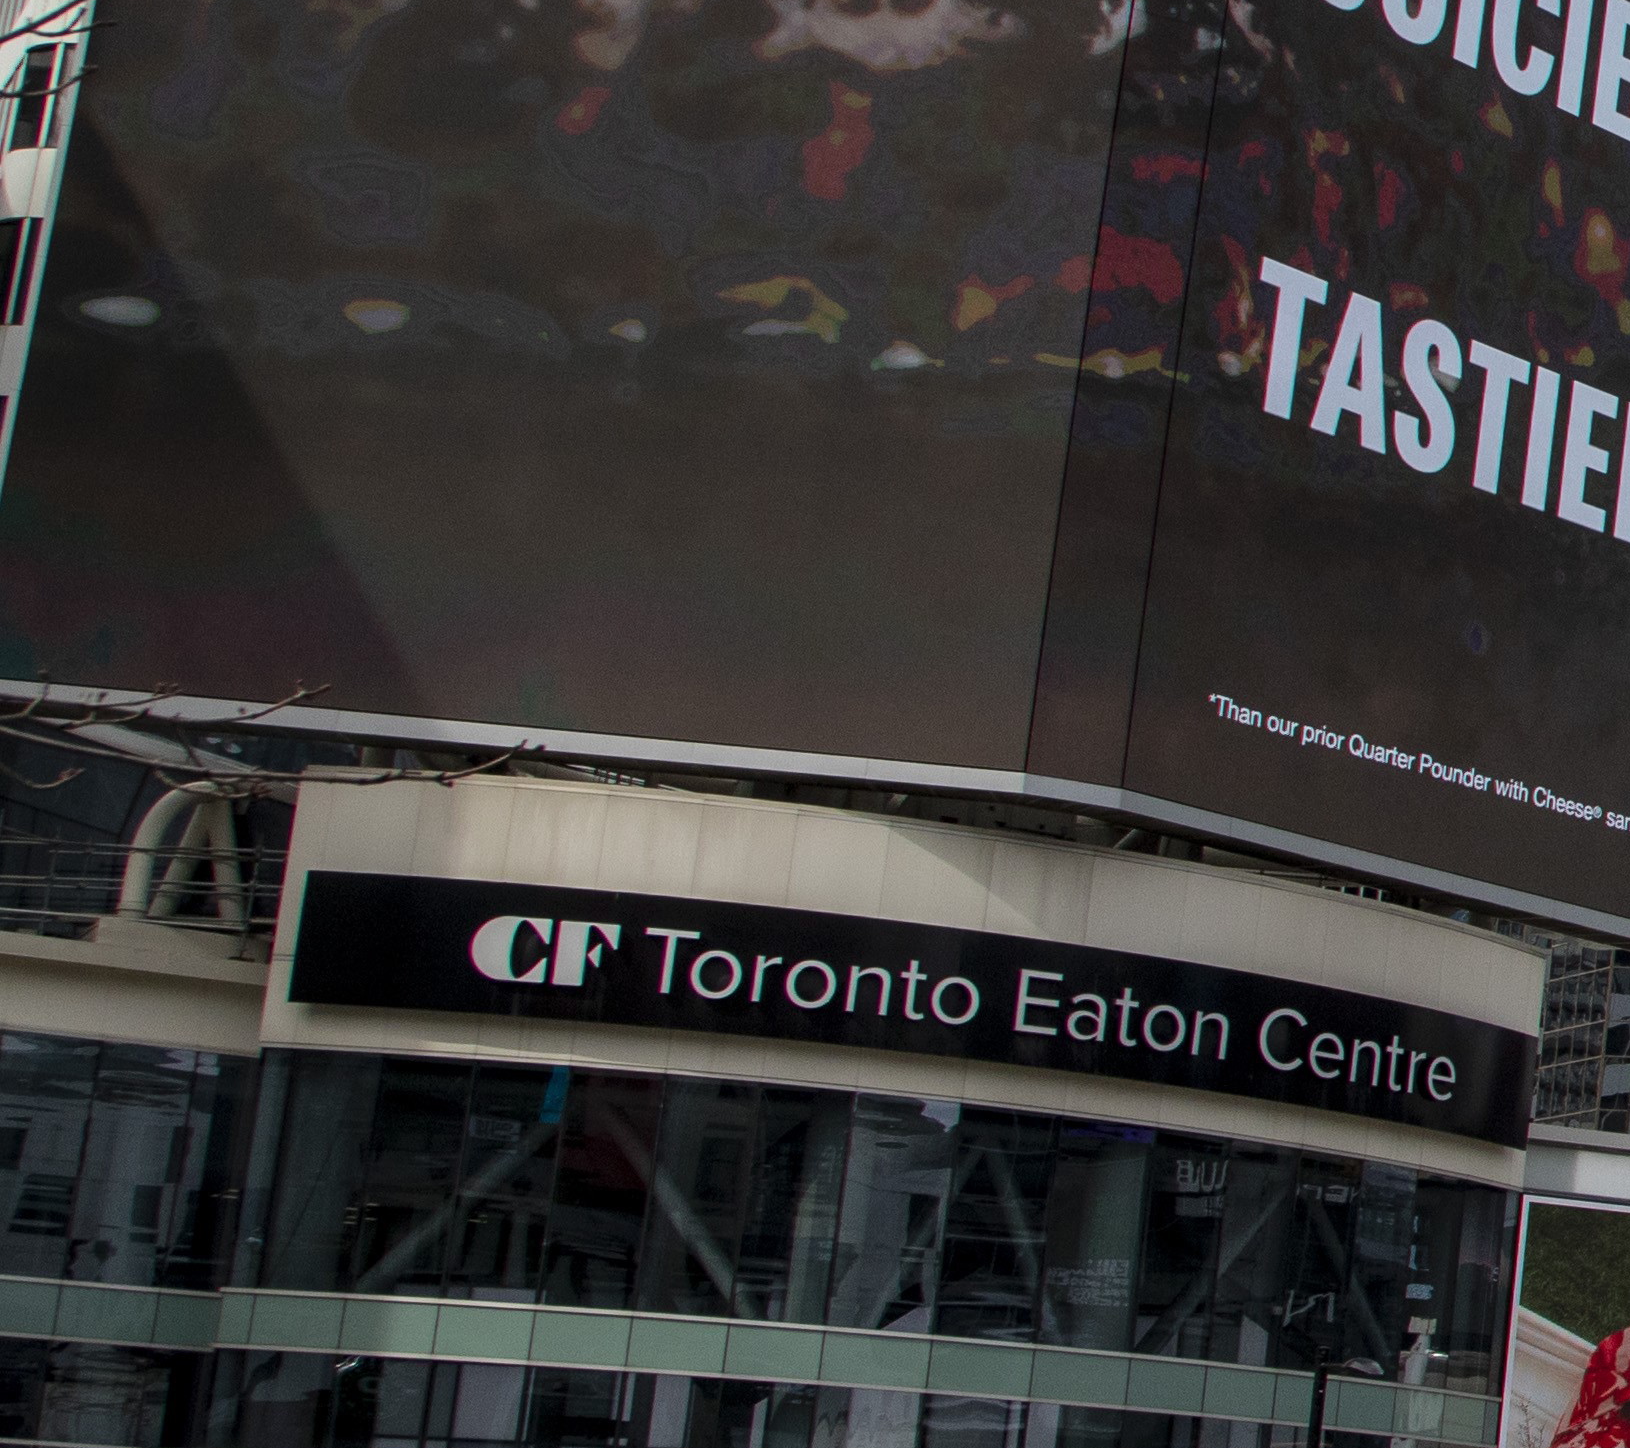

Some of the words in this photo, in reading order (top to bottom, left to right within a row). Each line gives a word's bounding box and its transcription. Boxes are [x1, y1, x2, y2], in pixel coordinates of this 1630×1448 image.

[1266, 713, 1298, 738] our
[1301, 721, 1345, 752] prior
[1348, 732, 1415, 771] Quarter
[1419, 753, 1492, 793] Pounder
[1494, 776, 1529, 804] with
[468, 915, 620, 986] CF
[644, 927, 980, 1026] Toronto
[1012, 969, 1232, 1061] Eaton
[1258, 1006, 1458, 1103] Centre
